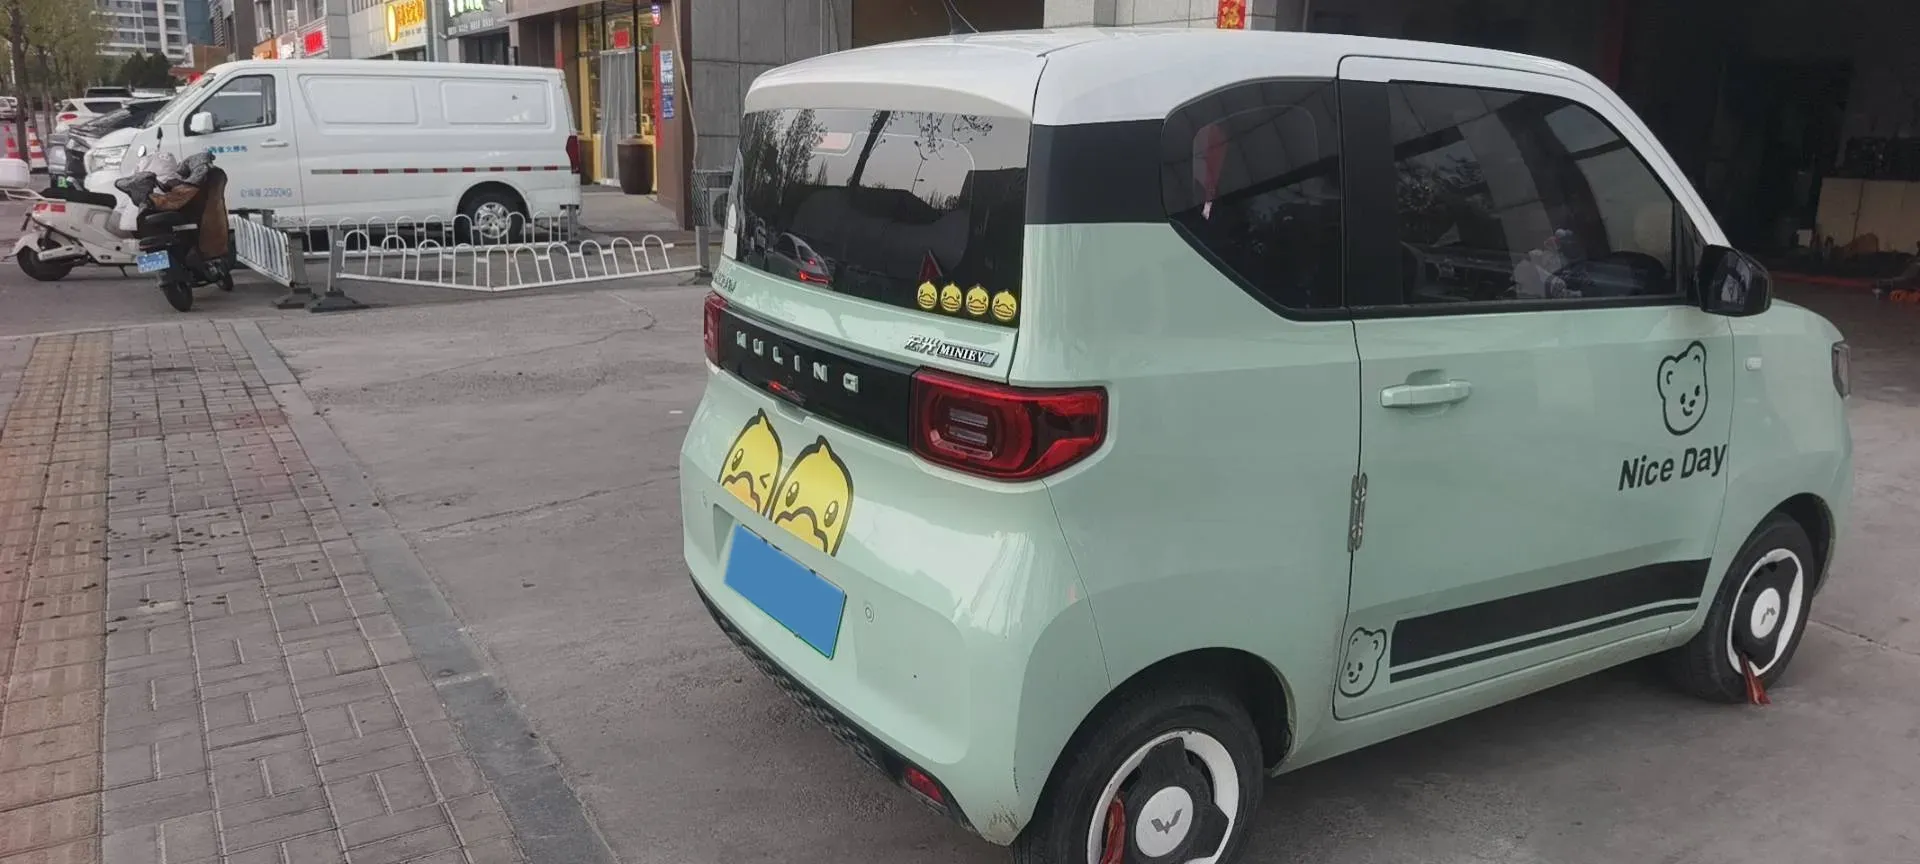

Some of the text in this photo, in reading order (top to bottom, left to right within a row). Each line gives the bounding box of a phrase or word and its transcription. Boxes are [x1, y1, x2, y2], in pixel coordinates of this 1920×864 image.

[736, 330, 859, 393] WULING
[939, 343, 986, 362] MINIEV
[1618, 443, 1727, 491] Nice Day
